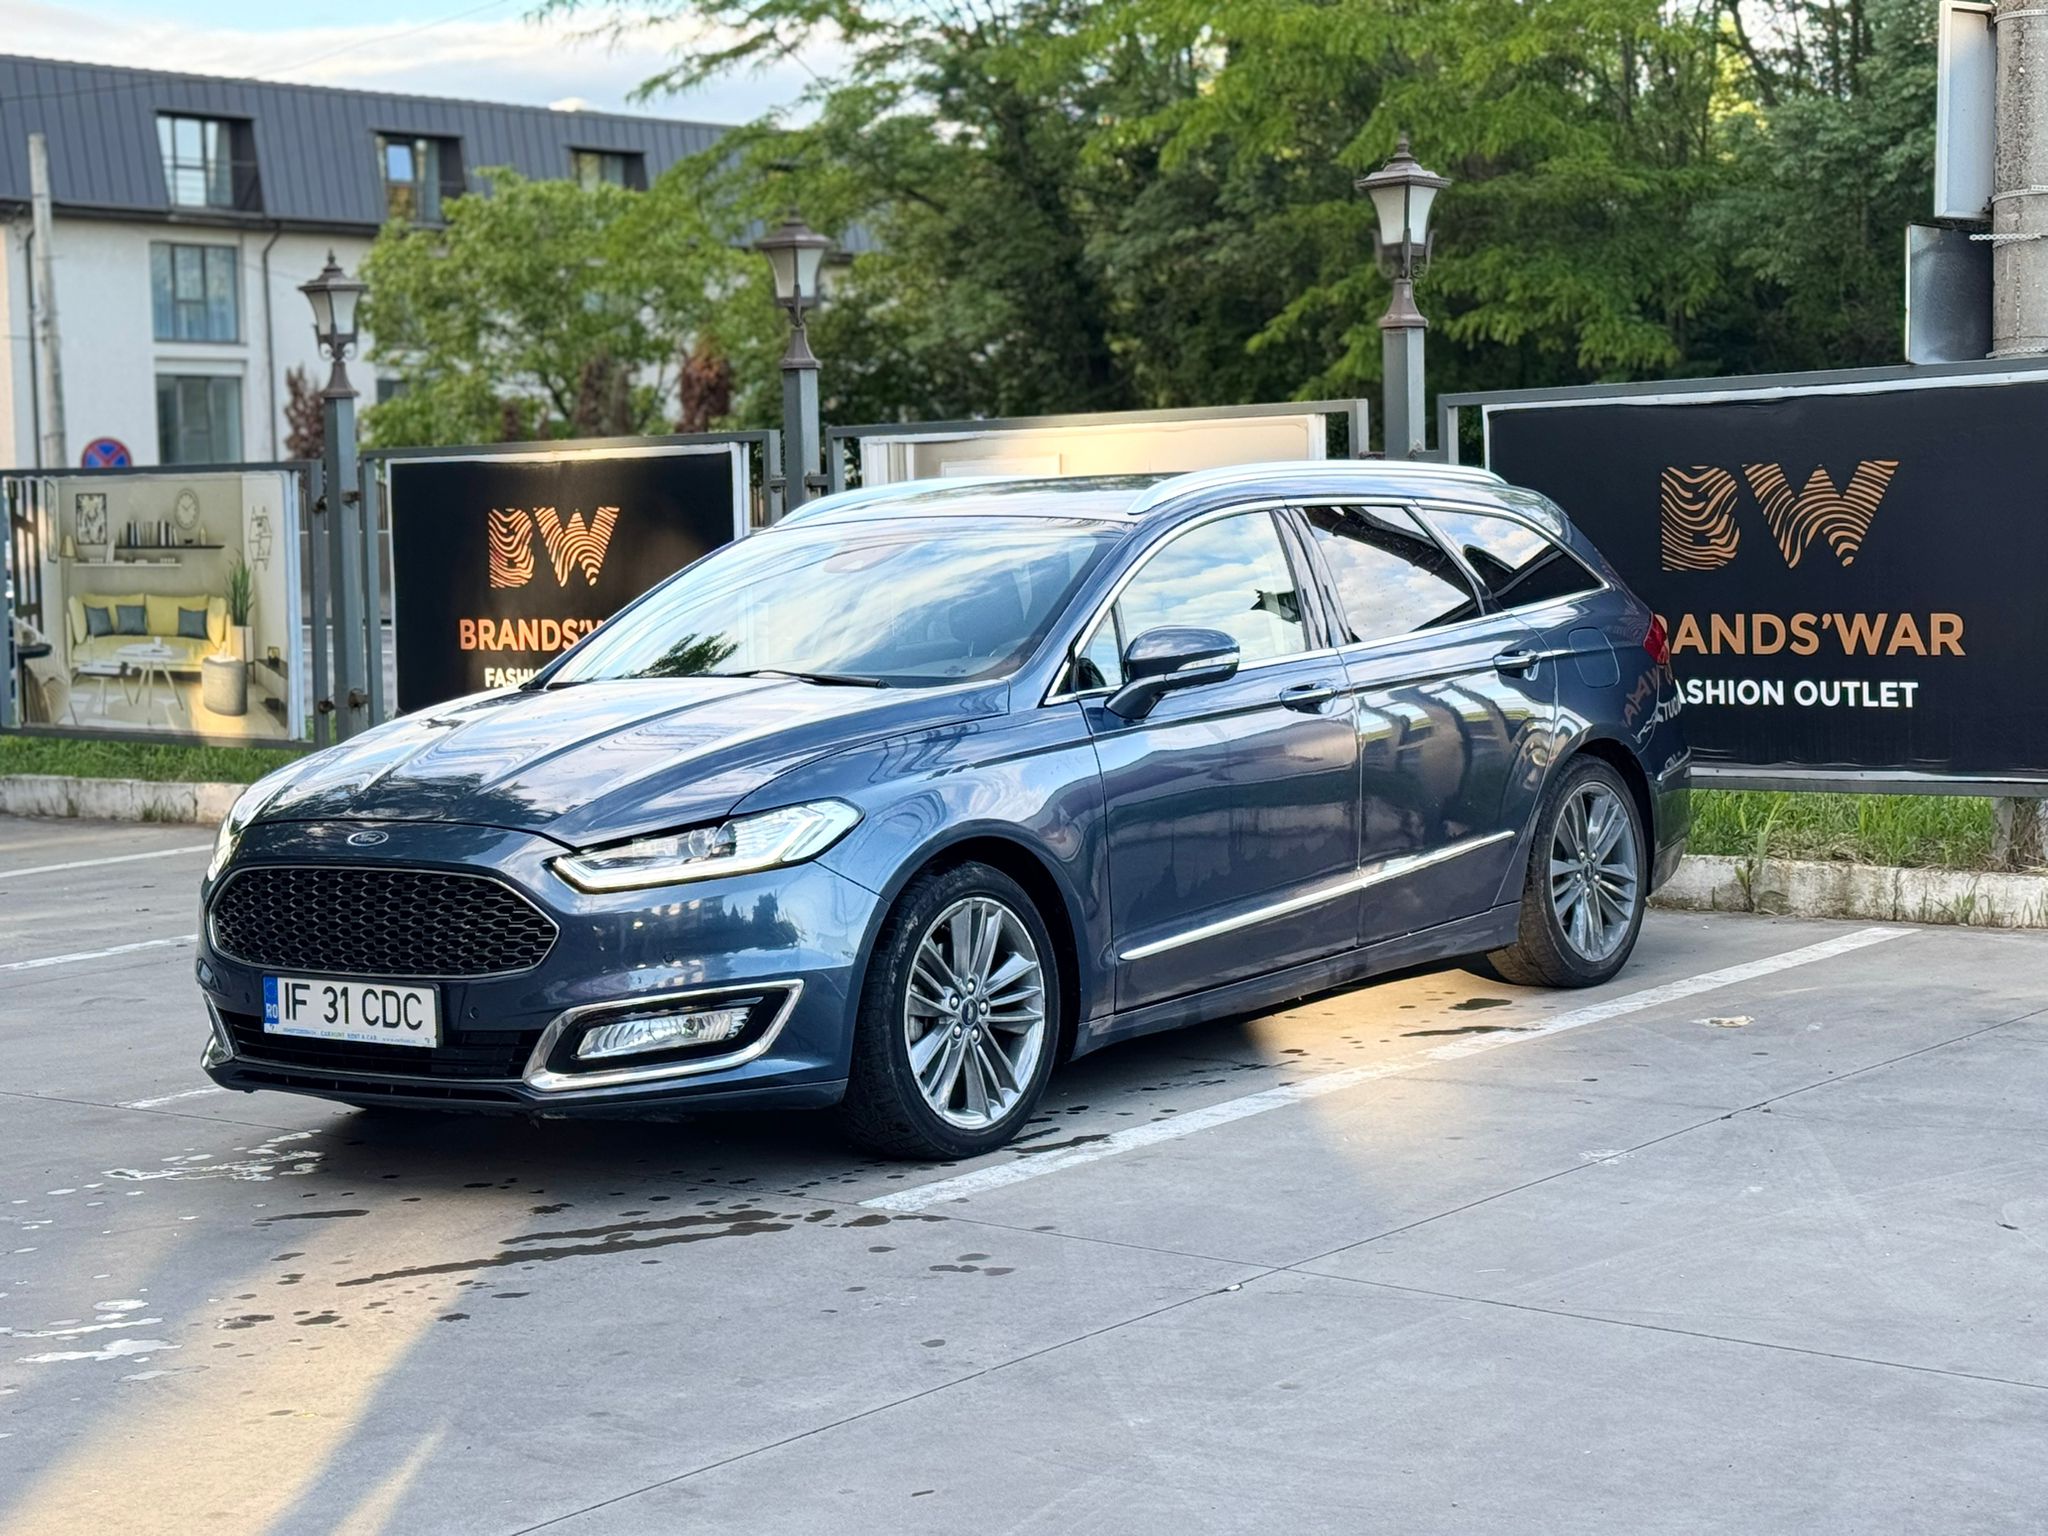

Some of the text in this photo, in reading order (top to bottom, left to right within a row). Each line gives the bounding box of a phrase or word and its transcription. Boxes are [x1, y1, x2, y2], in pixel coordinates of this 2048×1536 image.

[1660, 460, 1900, 572] BW
[488, 507, 620, 588] BW
[1654, 612, 1966, 656] ANDS'WAR
[485, 667, 541, 688] FASH
[1794, 680, 1919, 708] OUTLET
[266, 1003, 278, 1018] RO
[285, 982, 423, 1031] IF 31 CDC
